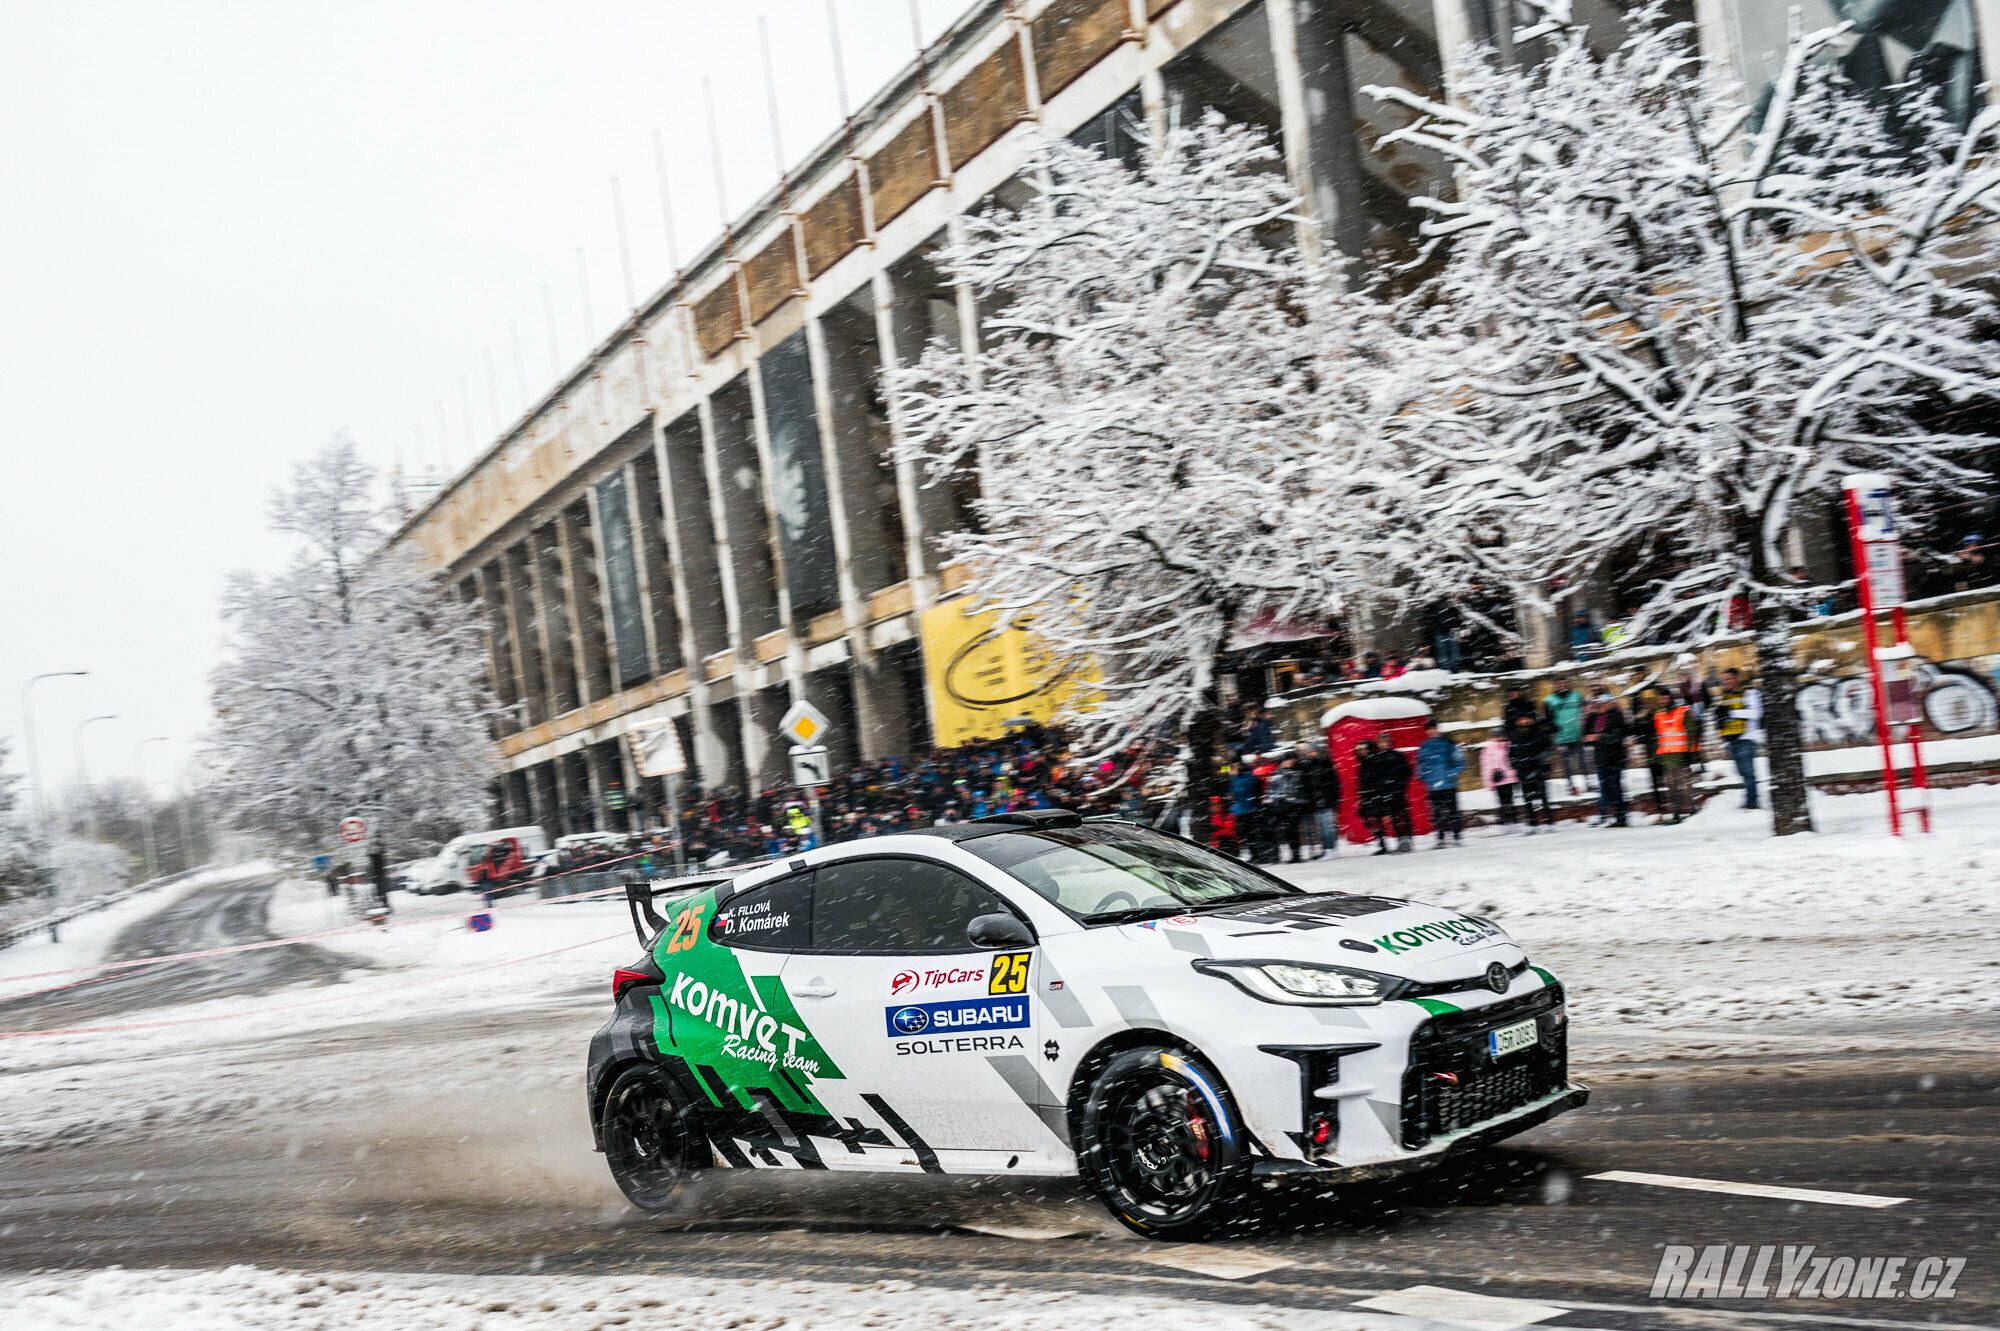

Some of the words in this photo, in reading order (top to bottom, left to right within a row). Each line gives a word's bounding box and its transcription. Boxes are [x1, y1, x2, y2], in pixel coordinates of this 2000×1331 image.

[728, 907, 736, 918] K.
[737, 899, 771, 917] FILLOVÁ
[666, 904, 706, 954] 25
[724, 919, 736, 935] D.
[738, 911, 791, 933] Komárek
[924, 968, 984, 988] TipCars
[990, 954, 1029, 994] 25
[933, 1005, 1023, 1027] SUBARU
[720, 1034, 778, 1072] Racing
[782, 1050, 821, 1073] team
[895, 1035, 1024, 1056] SOLTERRA
